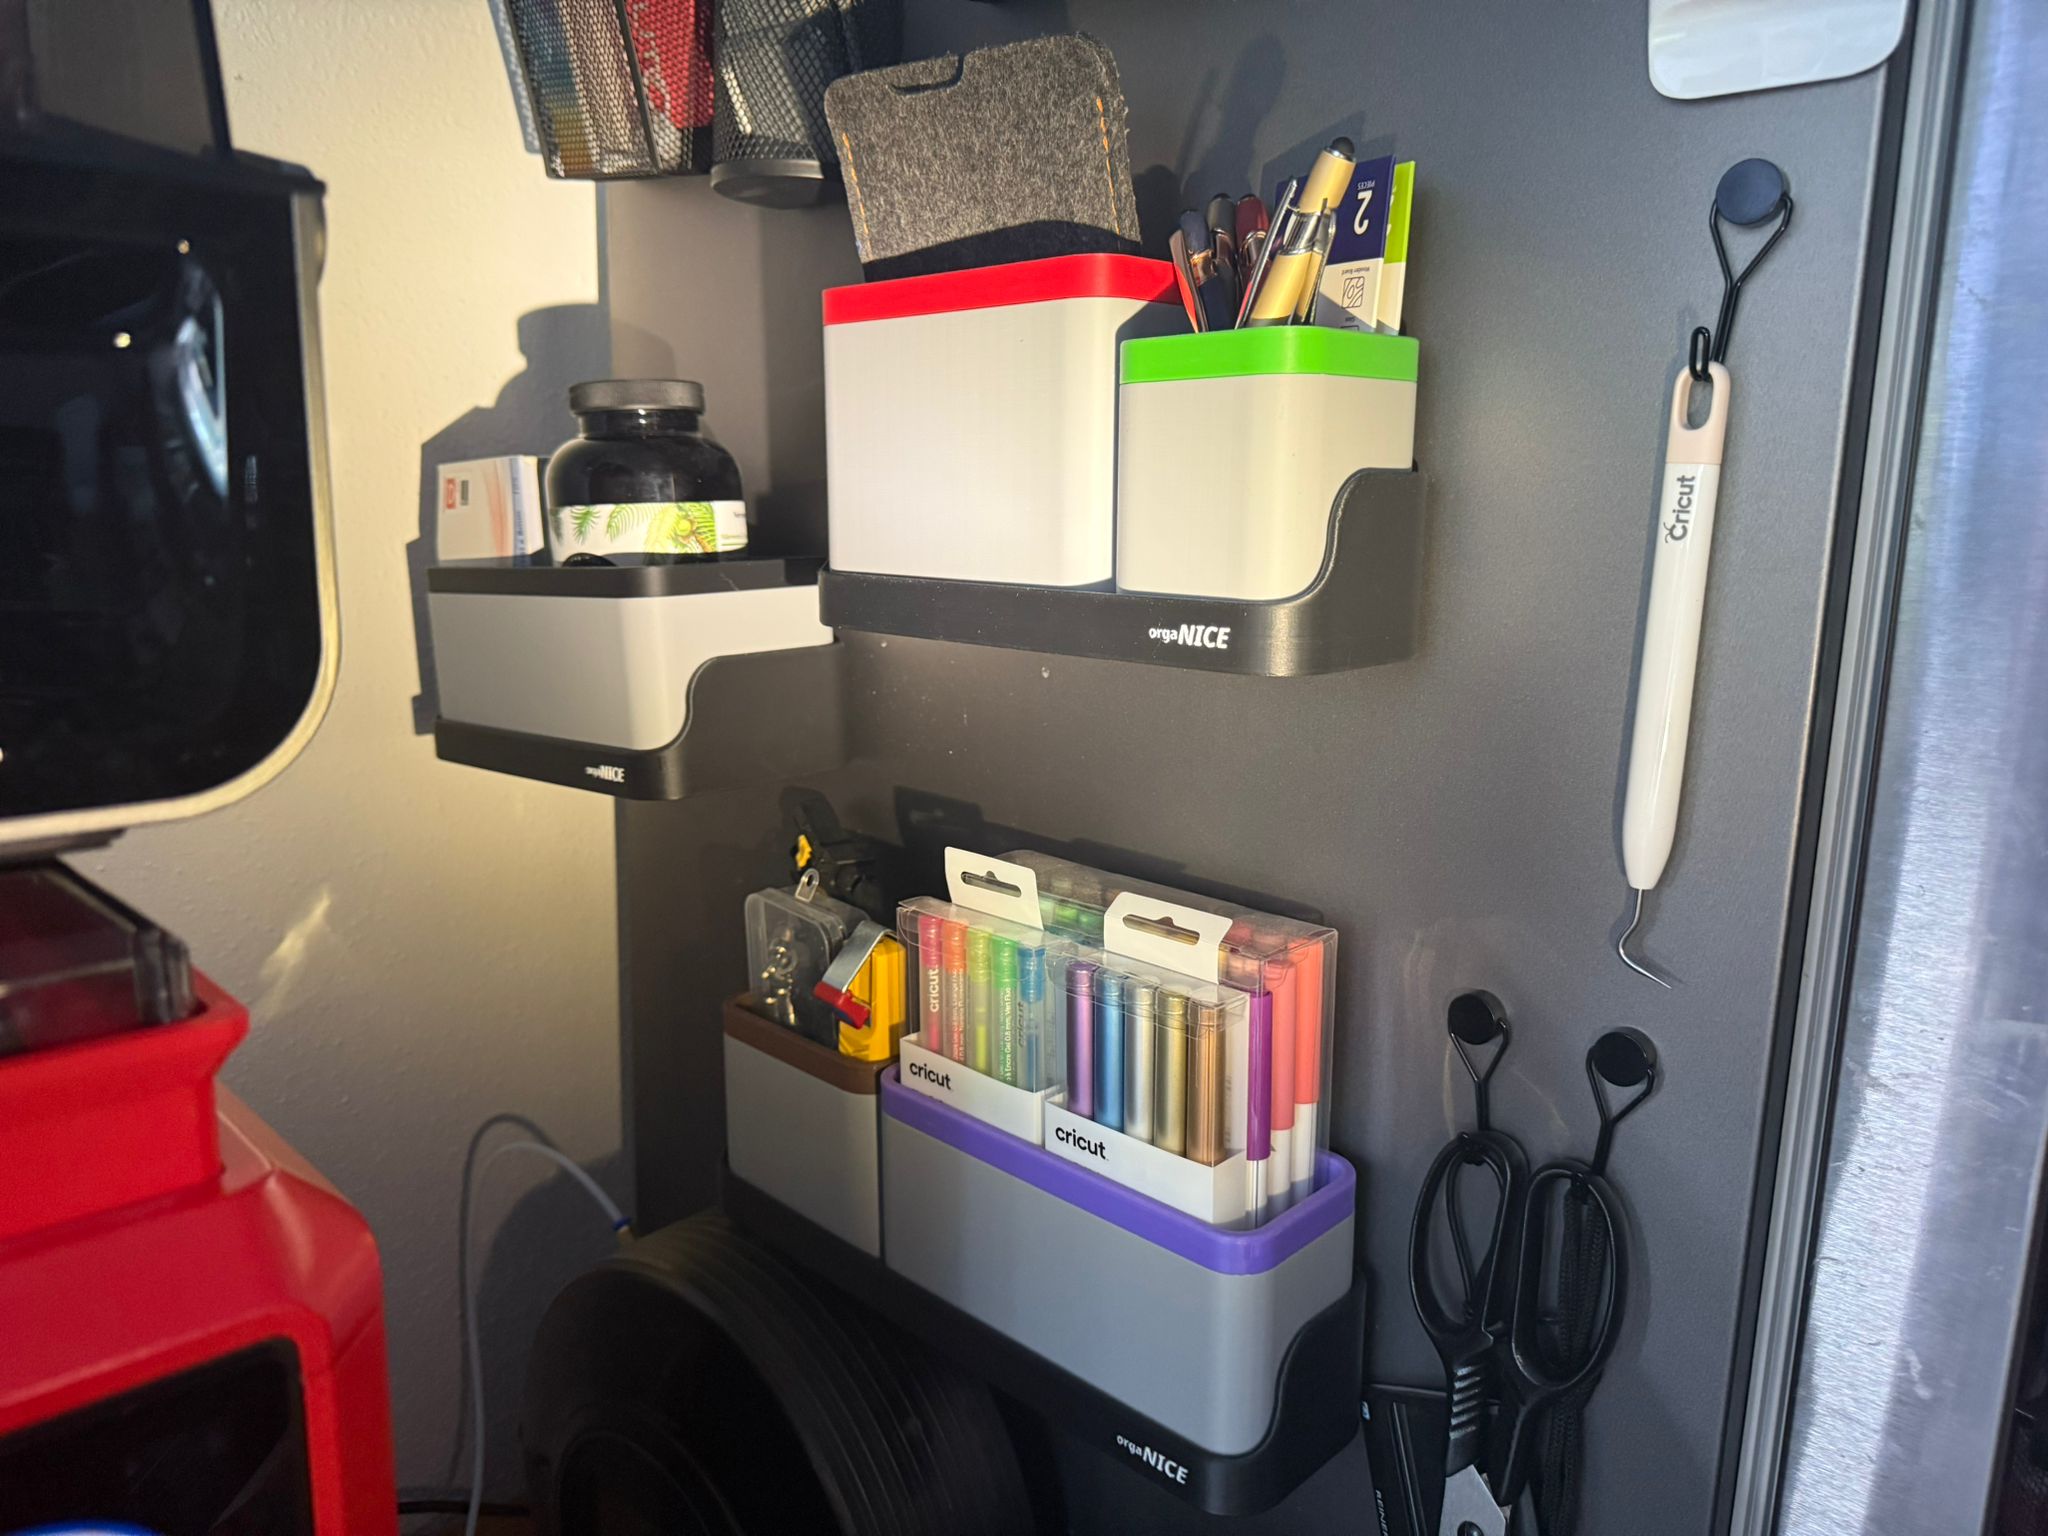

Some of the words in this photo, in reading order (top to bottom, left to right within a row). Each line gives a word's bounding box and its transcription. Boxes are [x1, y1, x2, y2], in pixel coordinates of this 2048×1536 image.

[1357, 180, 1376, 191] PIECES
[1354, 190, 1373, 235] 2
[1664, 474, 1696, 543] Cricut
[1148, 624, 1231, 649] orgaNICE
[928, 967, 940, 1013] cricut
[909, 1061, 952, 1091] cricut
[1055, 1126, 1106, 1160] cricut
[1116, 1435, 1188, 1484] orgaNICE
